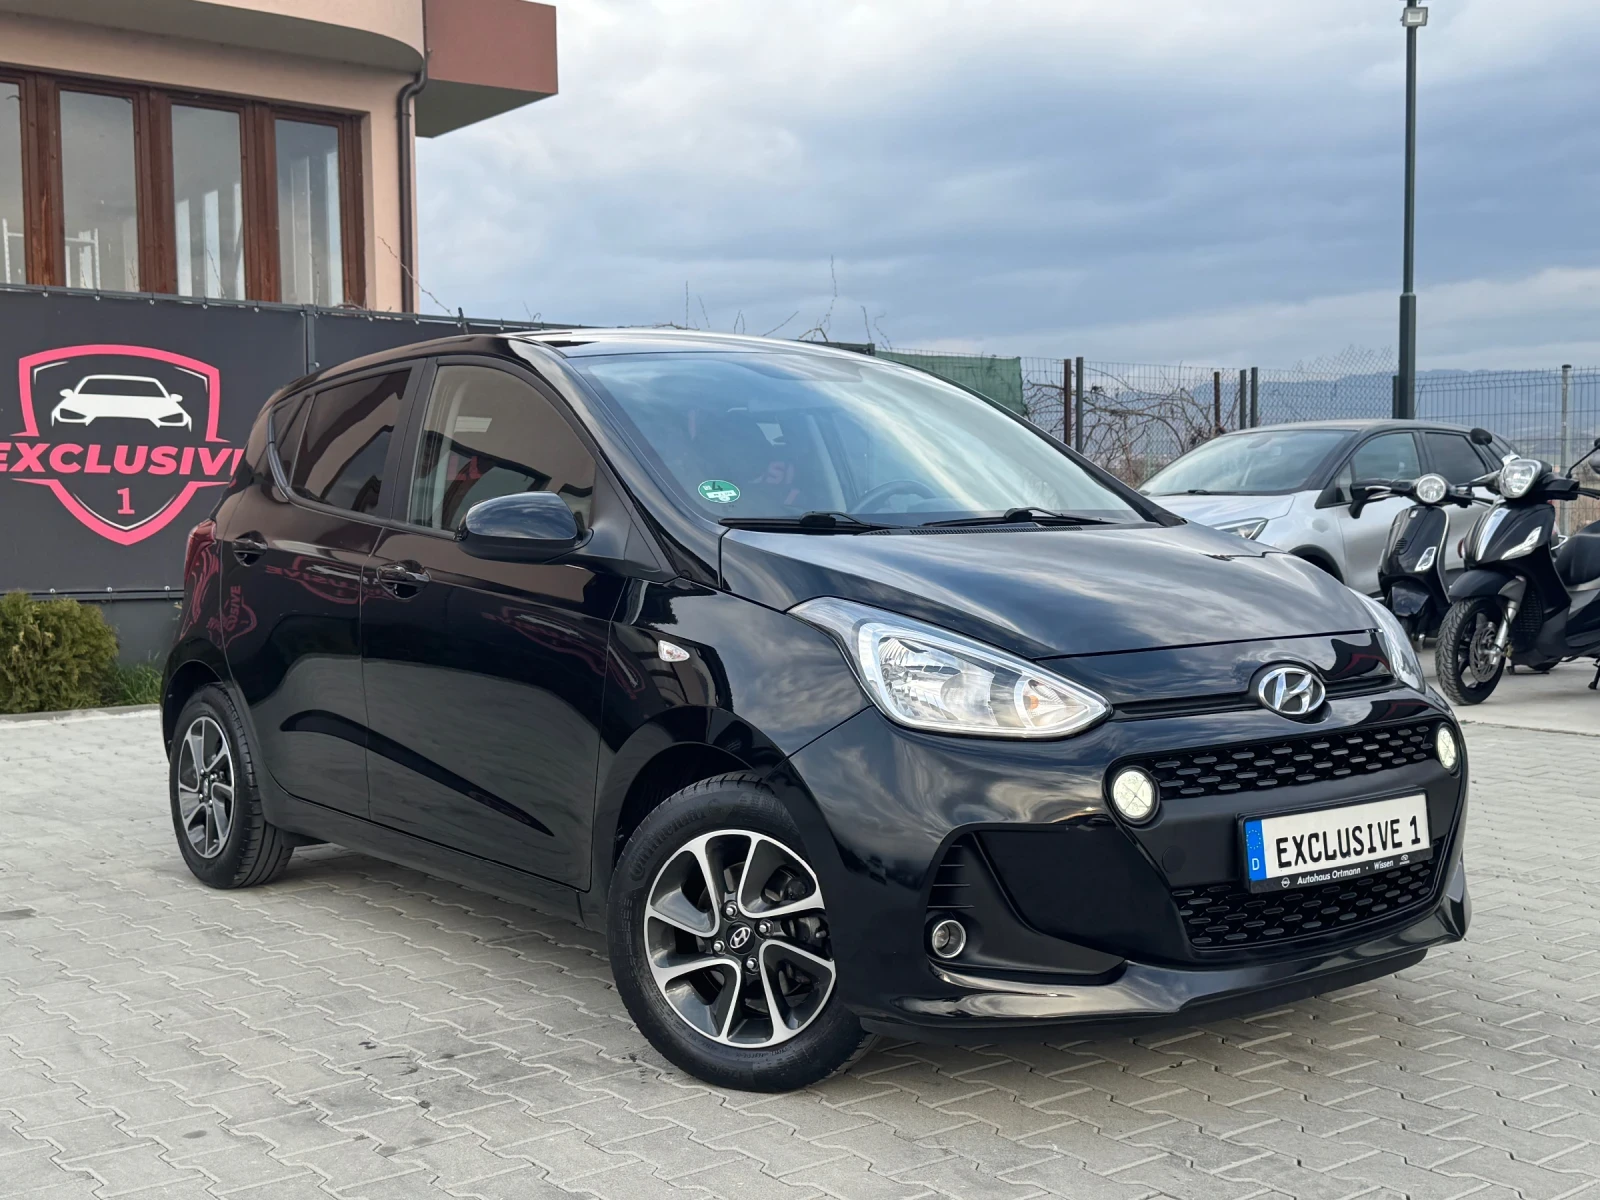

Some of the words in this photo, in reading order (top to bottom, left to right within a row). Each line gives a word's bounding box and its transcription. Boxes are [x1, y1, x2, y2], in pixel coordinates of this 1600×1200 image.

[117, 488, 135, 515] 1
[1276, 819, 1402, 868] EXCLUSIVE
[1410, 815, 1421, 845] 1
[1252, 858, 1260, 871] D
[1297, 872, 1331, 885] Autohaus
[1332, 867, 1361, 879] Ortmann
[1373, 860, 1394, 870] Wissen
